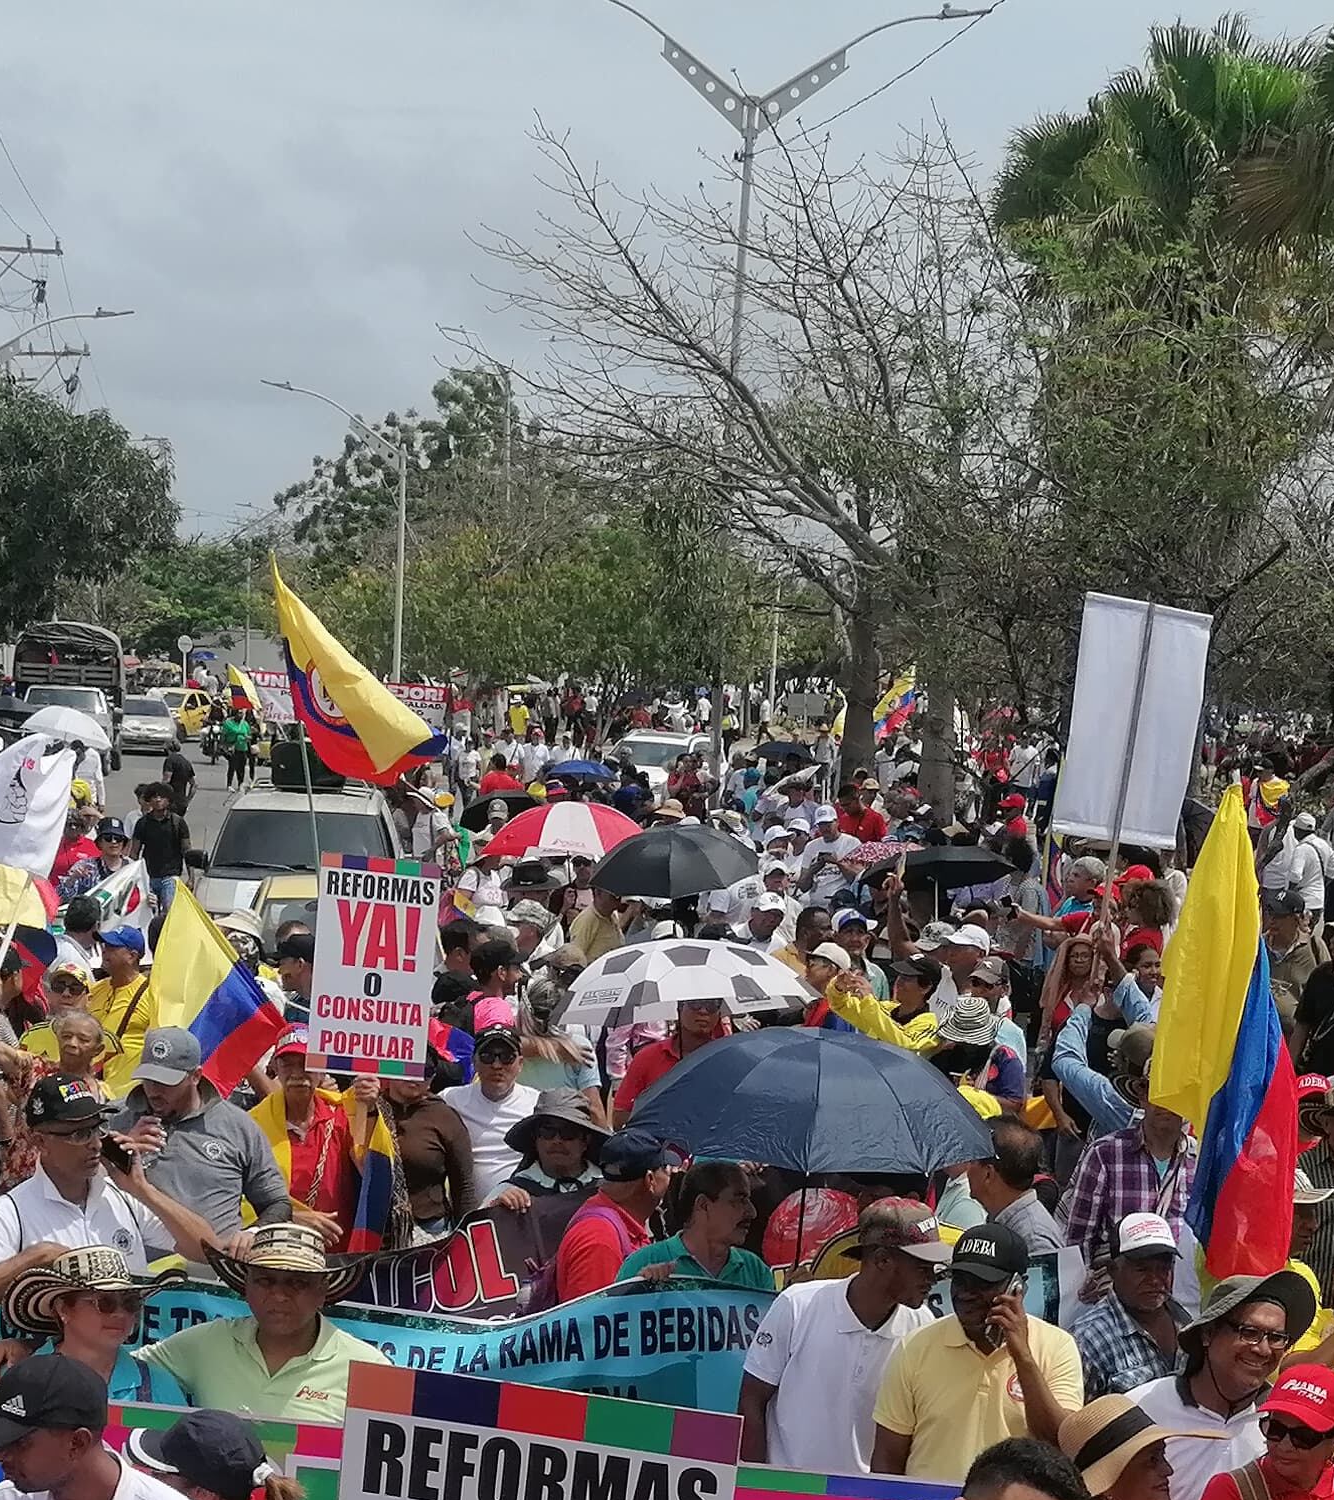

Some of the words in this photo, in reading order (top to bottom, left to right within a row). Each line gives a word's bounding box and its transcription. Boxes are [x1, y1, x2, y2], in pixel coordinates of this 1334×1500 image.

[327, 871, 435, 906] REFORMAS
[337, 899, 421, 973] YA!
[364, 972, 382, 997] O
[317, 994, 422, 1027] CONSULTA
[319, 1029, 415, 1060] POPULAR
[960, 1239, 997, 1258] ADEBA
[454, 1342, 489, 1373] LA
[499, 1317, 590, 1370] RAMA
[594, 1311, 630, 1361] DE
[639, 1303, 764, 1356] BEBIDAS
